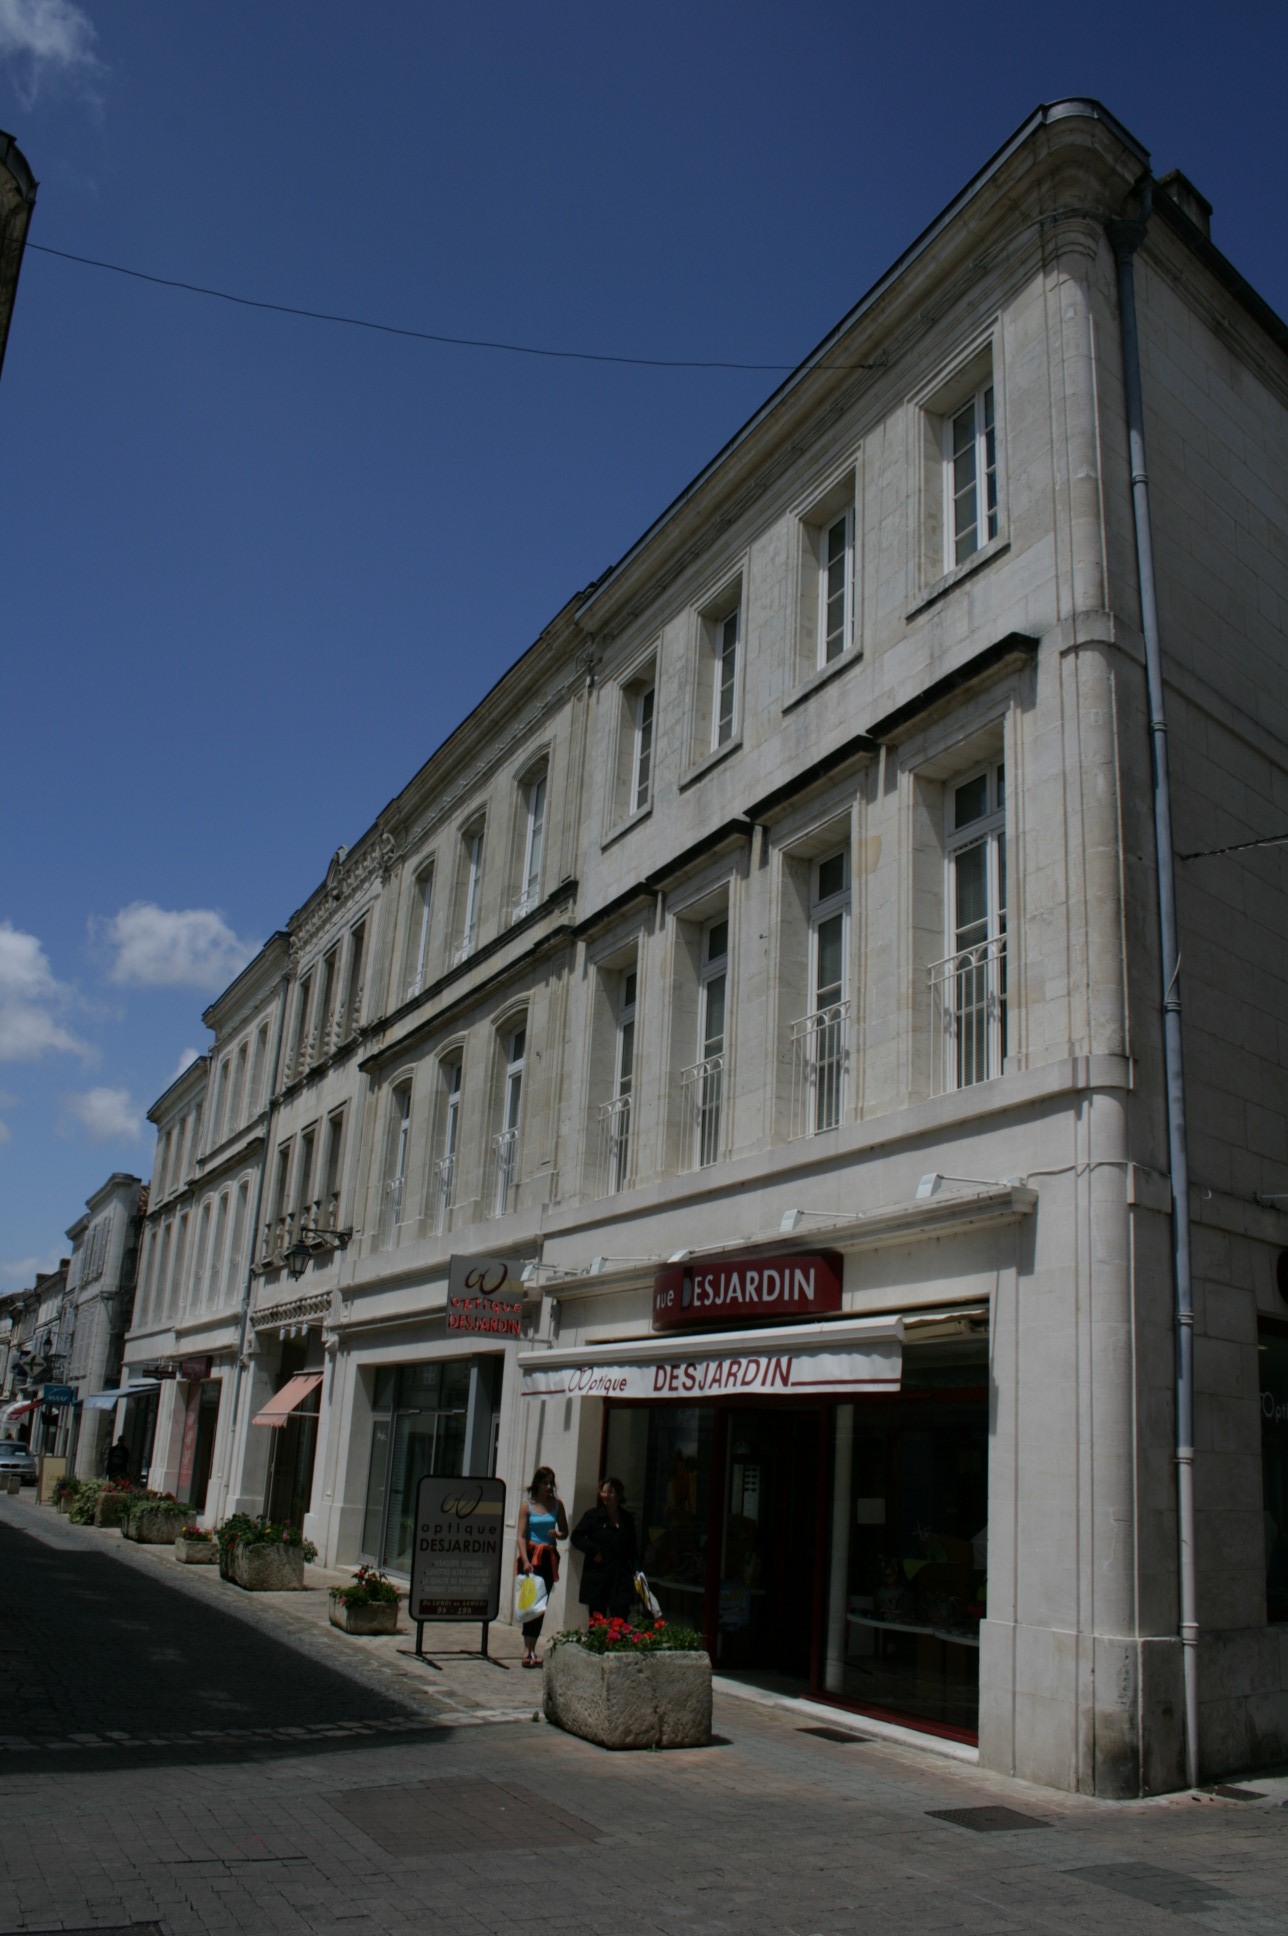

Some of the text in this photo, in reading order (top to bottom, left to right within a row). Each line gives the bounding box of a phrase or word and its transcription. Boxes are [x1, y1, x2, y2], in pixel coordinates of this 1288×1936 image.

[681, 1267, 816, 1309] DESJARDIN
[450, 1296, 523, 1315] optique
[448, 1313, 521, 1338] DESJARDIN
[652, 1356, 793, 1393] DESJARDIN
[421, 1522, 497, 1535] optique
[420, 1539, 496, 1553] DESJARDIN
